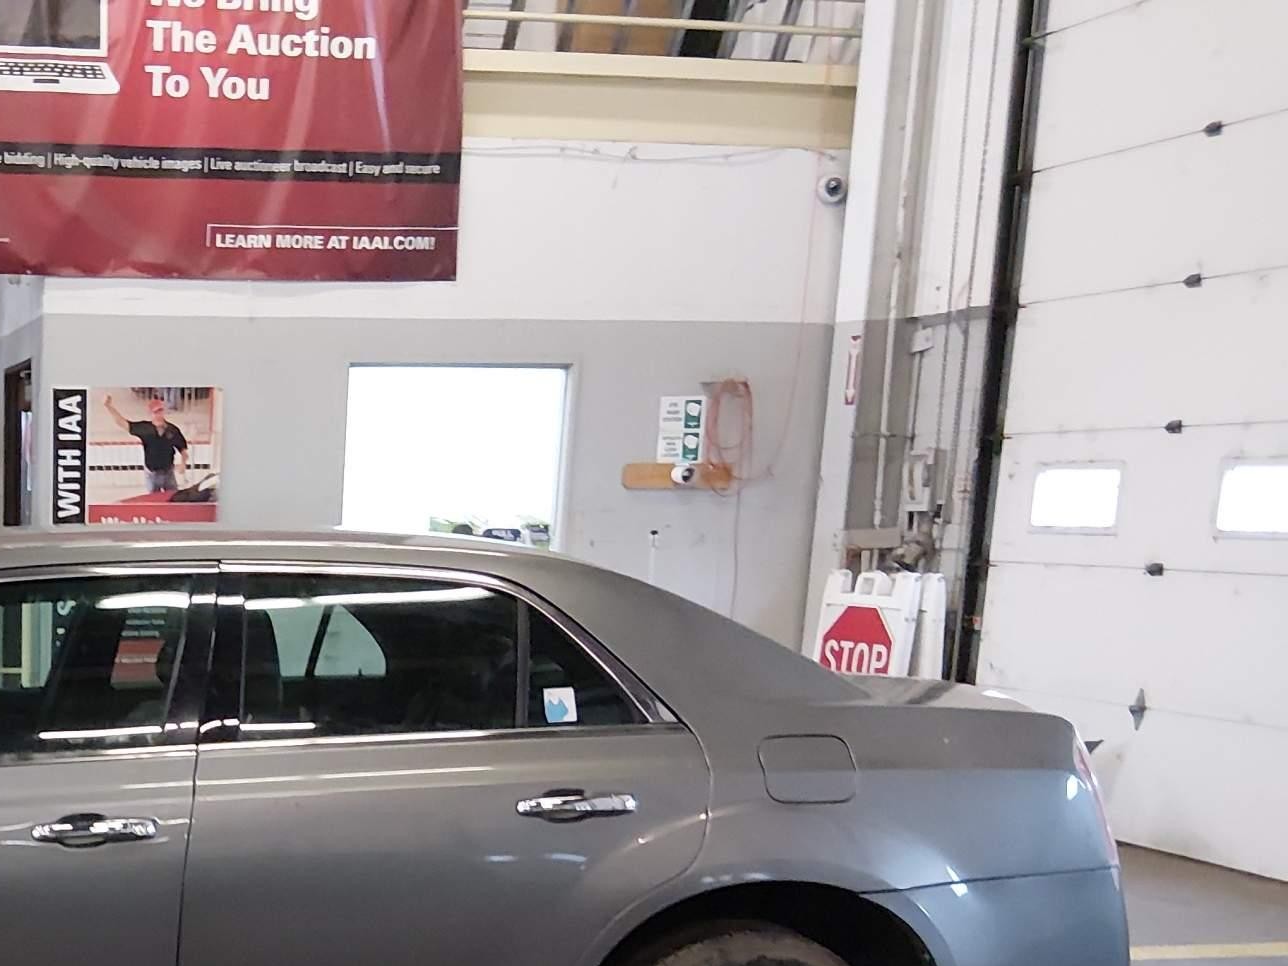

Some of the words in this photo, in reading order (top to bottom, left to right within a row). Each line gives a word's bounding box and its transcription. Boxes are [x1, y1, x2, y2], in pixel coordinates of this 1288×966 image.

[145, 20, 217, 53] The
[227, 23, 377, 59] Auction
[144, 65, 190, 98] To
[200, 66, 270, 100] You
[53, 153, 119, 170] High-quality
[120, 156, 160, 169] vehicle
[210, 157, 232, 171] Live
[355, 161, 380, 176] Easy
[215, 233, 272, 249] LEARN
[276, 234, 324, 250] MORE
[326, 235, 350, 250] AT
[58, 394, 82, 441] IAA
[57, 449, 82, 518] WITH
[824, 639, 889, 675] STOP
